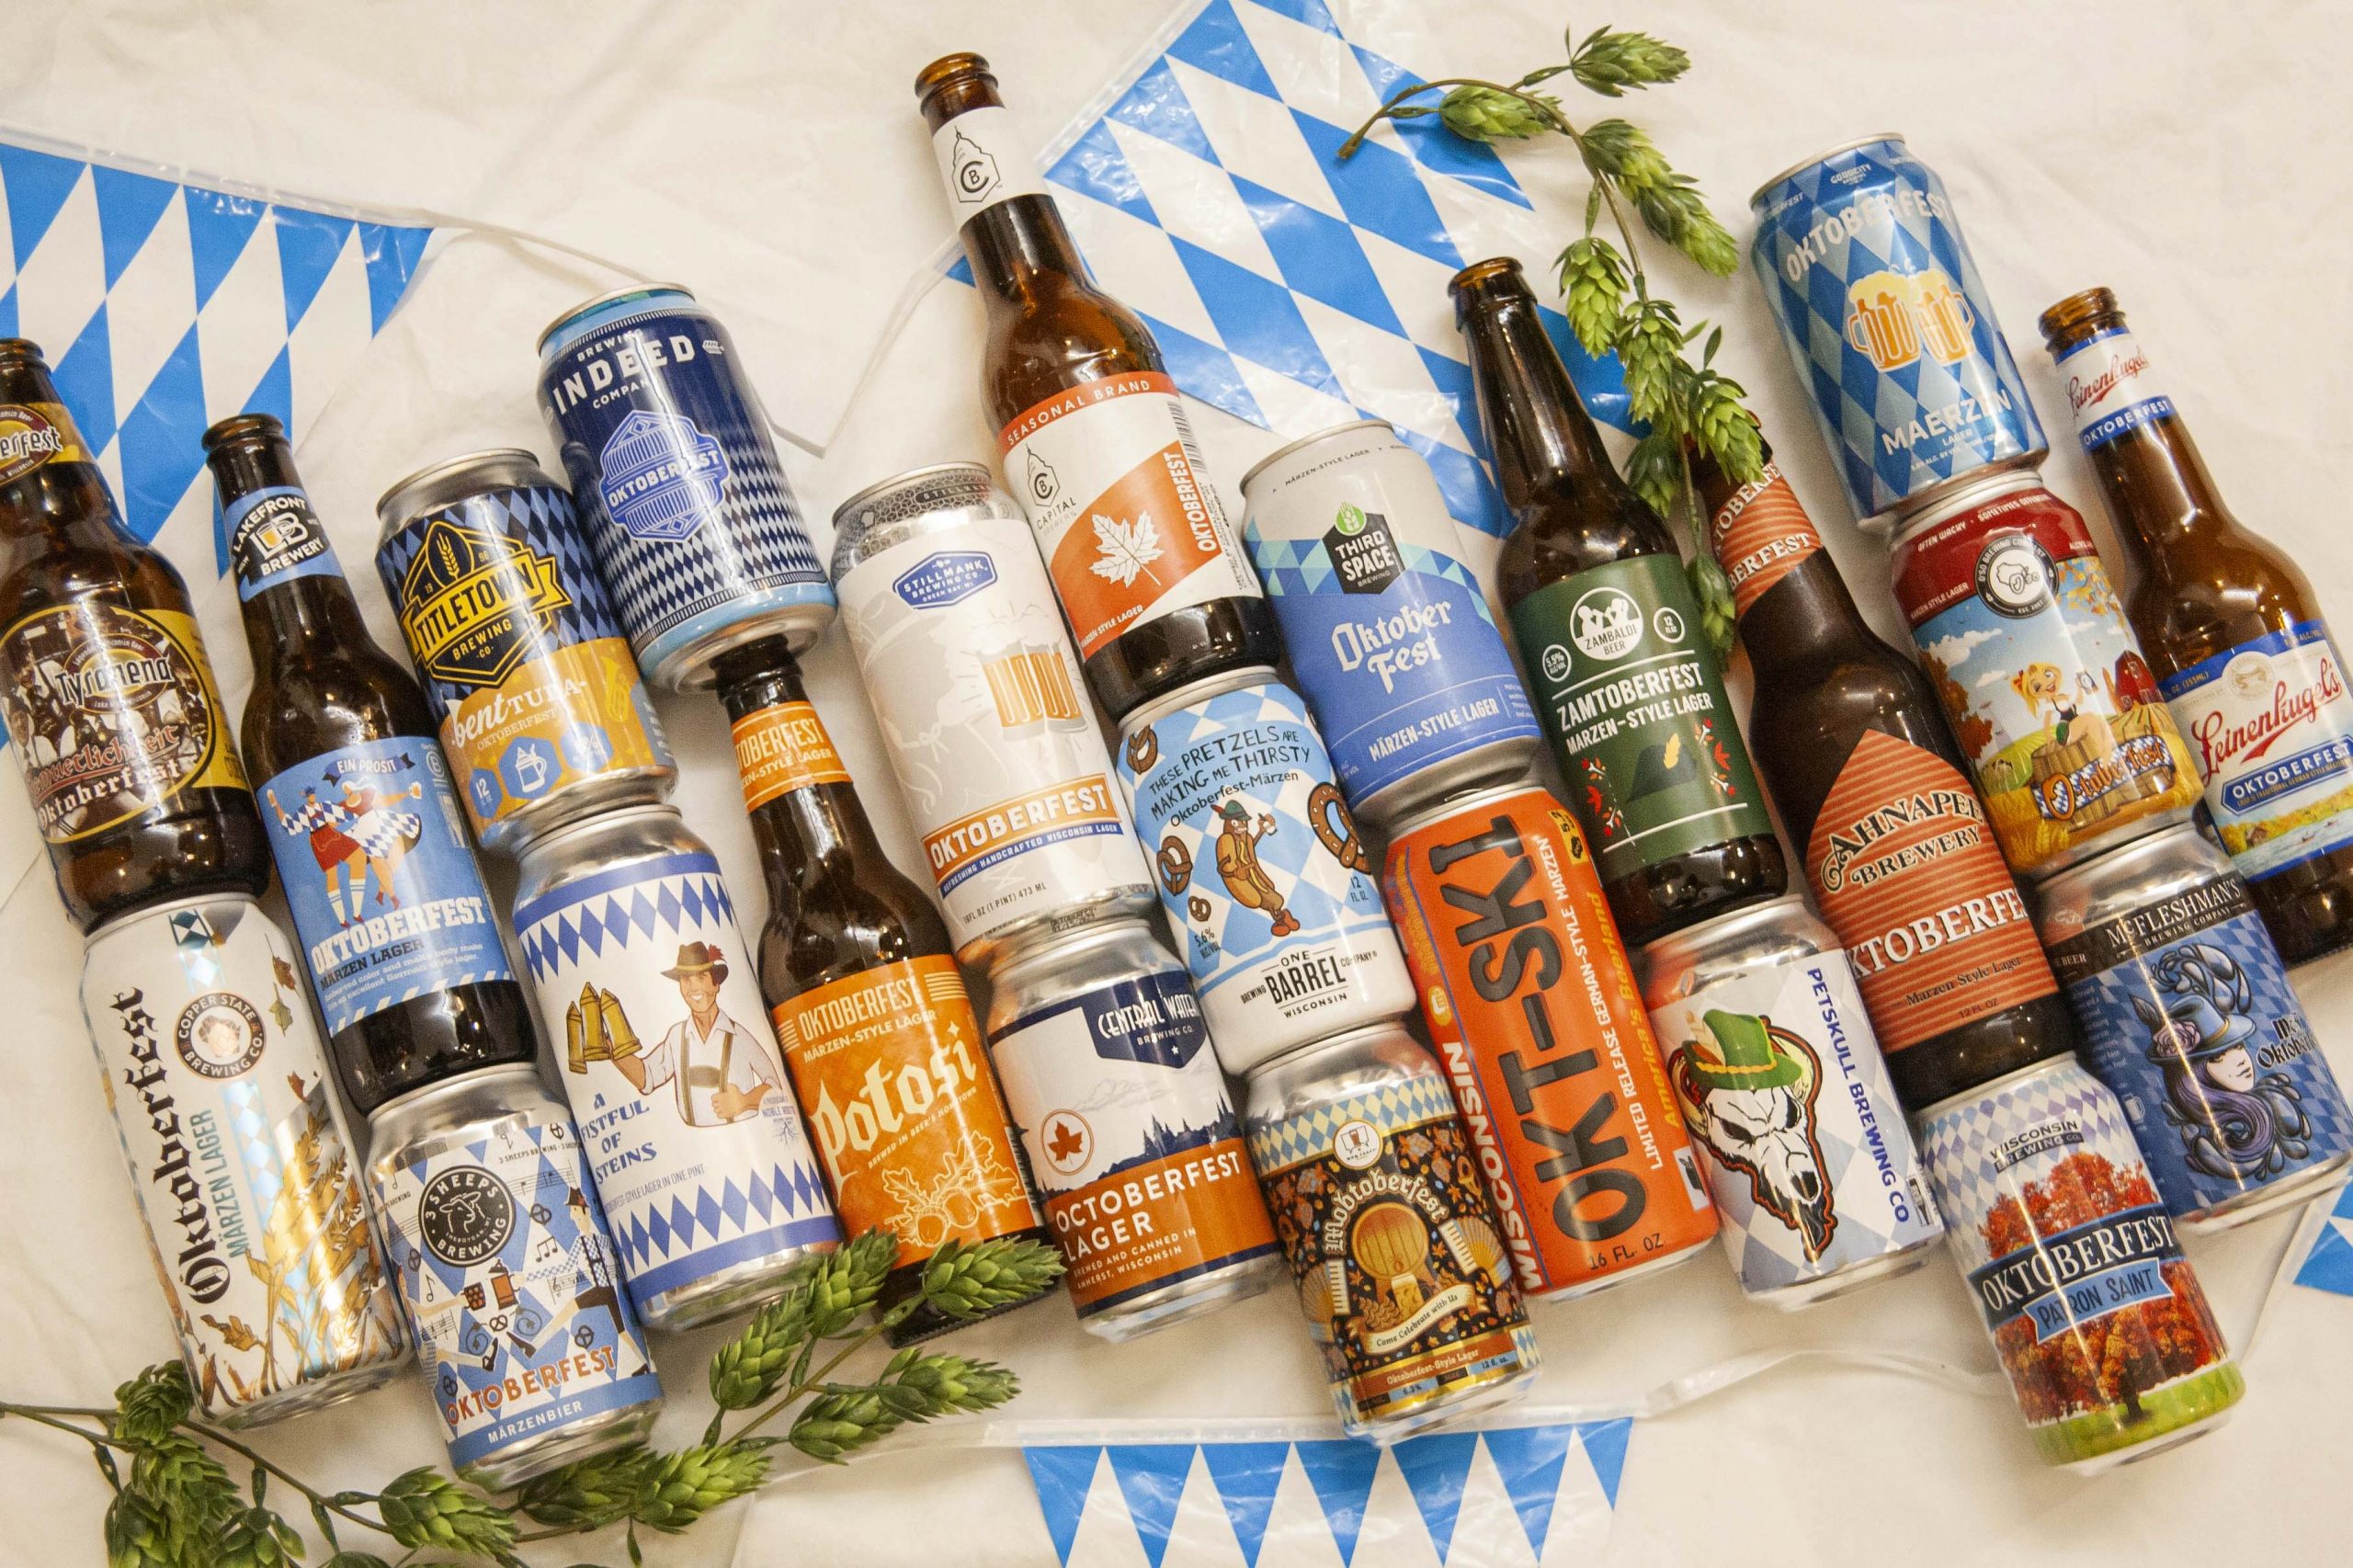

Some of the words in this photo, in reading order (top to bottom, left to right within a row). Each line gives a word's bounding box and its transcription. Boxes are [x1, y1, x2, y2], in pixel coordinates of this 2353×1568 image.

[1787, 190, 1952, 282] OKTOBERFEST
[552, 335, 695, 415] INDEED
[1007, 395, 1086, 446] SEASONAL
[1094, 380, 1150, 400] BRAND
[2084, 401, 2170, 446] OKTOBERFEST
[1345, 449, 1370, 460] LAGER
[1942, 428, 1972, 446] LAGER
[608, 449, 720, 507] OKTOBERST
[233, 497, 307, 551] LAKEFRONT
[1036, 496, 1077, 530] CAPITAL
[1163, 452, 1217, 551] OKTOBERFEST
[1978, 501, 2020, 522] SOMETIMES
[260, 537, 324, 575] BREWERY
[1336, 530, 1386, 559] THIRD
[1342, 545, 1394, 581] SPACE
[1985, 540, 2010, 562] BREWING
[904, 560, 984, 593] STILLMANK
[912, 576, 961, 598] BREWING
[948, 585, 961, 594] BAY
[1358, 570, 1391, 587] BREWING
[1928, 593, 1945, 608] STYLE
[1946, 582, 1970, 599] LAGER
[416, 562, 536, 652] TITLETOWN
[1097, 617, 1117, 638] STYLE
[1115, 605, 1144, 626] LAGER
[452, 618, 513, 661] BREWING
[1331, 599, 1452, 673] Oktober
[1585, 624, 1637, 650] ZAMBALDI
[1603, 641, 1626, 655] BEER
[1367, 633, 1442, 695] Fest
[1546, 654, 1564, 668] 5.5%
[1557, 663, 1703, 732] ZAMTOBERFEST
[445, 696, 508, 749] bent
[477, 708, 563, 751] OKTOBERFEST
[1369, 712, 1461, 763] MÄRZEN-STYLE
[1464, 697, 1500, 723] LAGER
[1566, 700, 1674, 755] MARZEN-STYLE
[1674, 692, 1714, 715] LAGER
[2191, 657, 2342, 785] Leinenkugel's
[336, 759, 357, 774] EIN
[358, 757, 397, 773] PROSIT
[735, 718, 824, 770] TOBERFEST
[796, 748, 833, 764] LAGER
[1149, 765, 1184, 795] THESE
[1181, 726, 1279, 770] PRETZELS
[1282, 731, 1300, 743] ARE
[475, 778, 490, 800] 12
[1151, 770, 1209, 822] MAKING
[1212, 766, 1231, 781] ME
[1229, 745, 1310, 773] THIRSTY
[2232, 742, 2350, 799] OKTOBERFEST
[1171, 771, 1299, 827] Oktoberfest-Märzen
[930, 784, 1108, 869] OKTOBERFEST
[1822, 791, 1984, 892] AHNAPEE
[943, 862, 978, 893] REFRESHING
[980, 836, 1043, 868] HANDCRAFTED
[1047, 825, 1094, 843] WISCONSIN
[1096, 824, 1119, 835] LAGER
[1851, 825, 1981, 886] BREWERY
[995, 893, 1017, 908] PINT)
[1018, 886, 1033, 898] 473
[1035, 881, 1048, 892] ML
[1350, 876, 1361, 890] 12
[311, 896, 486, 975] OKTOBERFEST
[1195, 927, 1215, 948] 5.6%
[1586, 892, 1634, 1000] Beerland
[1847, 888, 2029, 980] KTOBERFE
[2144, 923, 2190, 947] BREWING
[2193, 908, 2231, 926] COMPANY
[370, 938, 425, 966] LAGER
[1280, 950, 1311, 967] ONE
[1561, 904, 1611, 1026] GERMAN-STYLE
[2062, 954, 2086, 965] BEER
[1241, 984, 1267, 1004] BREWING
[1265, 955, 1347, 1005] BARREL
[1906, 981, 1955, 1006] Marzen
[1957, 965, 1989, 988] Style
[1991, 955, 2022, 976] Lager
[178, 995, 217, 1039] COPPER
[221, 994, 256, 1021] STATE
[799, 976, 923, 1040] OKTOBERFEST
[1097, 1002, 1165, 1039] CENTRAL
[1284, 993, 1347, 1018] WISCONSIN
[184, 1051, 251, 1076] BREWING
[249, 1033, 263, 1057] CO.
[803, 1021, 893, 1063] MÄRZEN-STYLE
[895, 1010, 938, 1030] LAGER
[1602, 1027, 1637, 1098] RELEASE
[1631, 1006, 1679, 1129] America's
[594, 1093, 606, 1109] A
[1807, 967, 1851, 1081] PETSKULL
[1848, 1081, 1897, 1187] BREWING
[1889, 1190, 1910, 1223] CO
[188, 1109, 228, 1176] LAGER
[580, 1099, 650, 1143] FISTFUL
[601, 1131, 621, 1153] OF
[1629, 1103, 1663, 1170] LIMITED
[1990, 1121, 2078, 1158] WISCONSIN
[109, 985, 232, 1304] Oktoberfest
[506, 1151, 530, 1162] SHEEPS
[530, 1145, 558, 1155] BREWING
[596, 1142, 657, 1185] STEINS
[868, 1141, 896, 1169] BREWED
[896, 1132, 909, 1145] IN
[1444, 1040, 1543, 1290] WISCONSIN
[1997, 1138, 2063, 1170] BREWING
[429, 1174, 501, 1206] SHEEPS
[641, 1179, 663, 1198] LAGER
[662, 1176, 671, 1189] IN
[671, 1170, 688, 1184] ONE
[688, 1164, 705, 1179] PINT
[1056, 1151, 1241, 1233] OCTOBERFEST
[208, 1175, 250, 1258] MÄRZEN
[426, 1210, 436, 1221] 3
[1064, 1211, 1154, 1262] LAGER
[437, 1219, 506, 1259] BREWING
[1074, 1259, 1103, 1278] BREWED
[1107, 1252, 1127, 1265] AND
[1131, 1233, 1178, 1256] CANNED
[1184, 1228, 1196, 1238] IN
[1589, 1252, 1607, 1271] 16
[1077, 1272, 1114, 1289] AMHERST,
[1117, 1245, 1182, 1273] WISCONSIN
[1983, 1216, 2175, 1312] OKTOBERFEST
[1376, 1335, 1397, 1346] Come
[1399, 1312, 1431, 1338] Celebrate
[1431, 1299, 1448, 1313] with
[1449, 1294, 1458, 1302] Us
[2037, 1292, 2101, 1331] PATRON
[2110, 1267, 2155, 1301] SAINT
[1457, 1349, 1479, 1362] Lager
[448, 1345, 616, 1426] OKTOBERFEST
[488, 1400, 583, 1445] MÄRZENBIER
